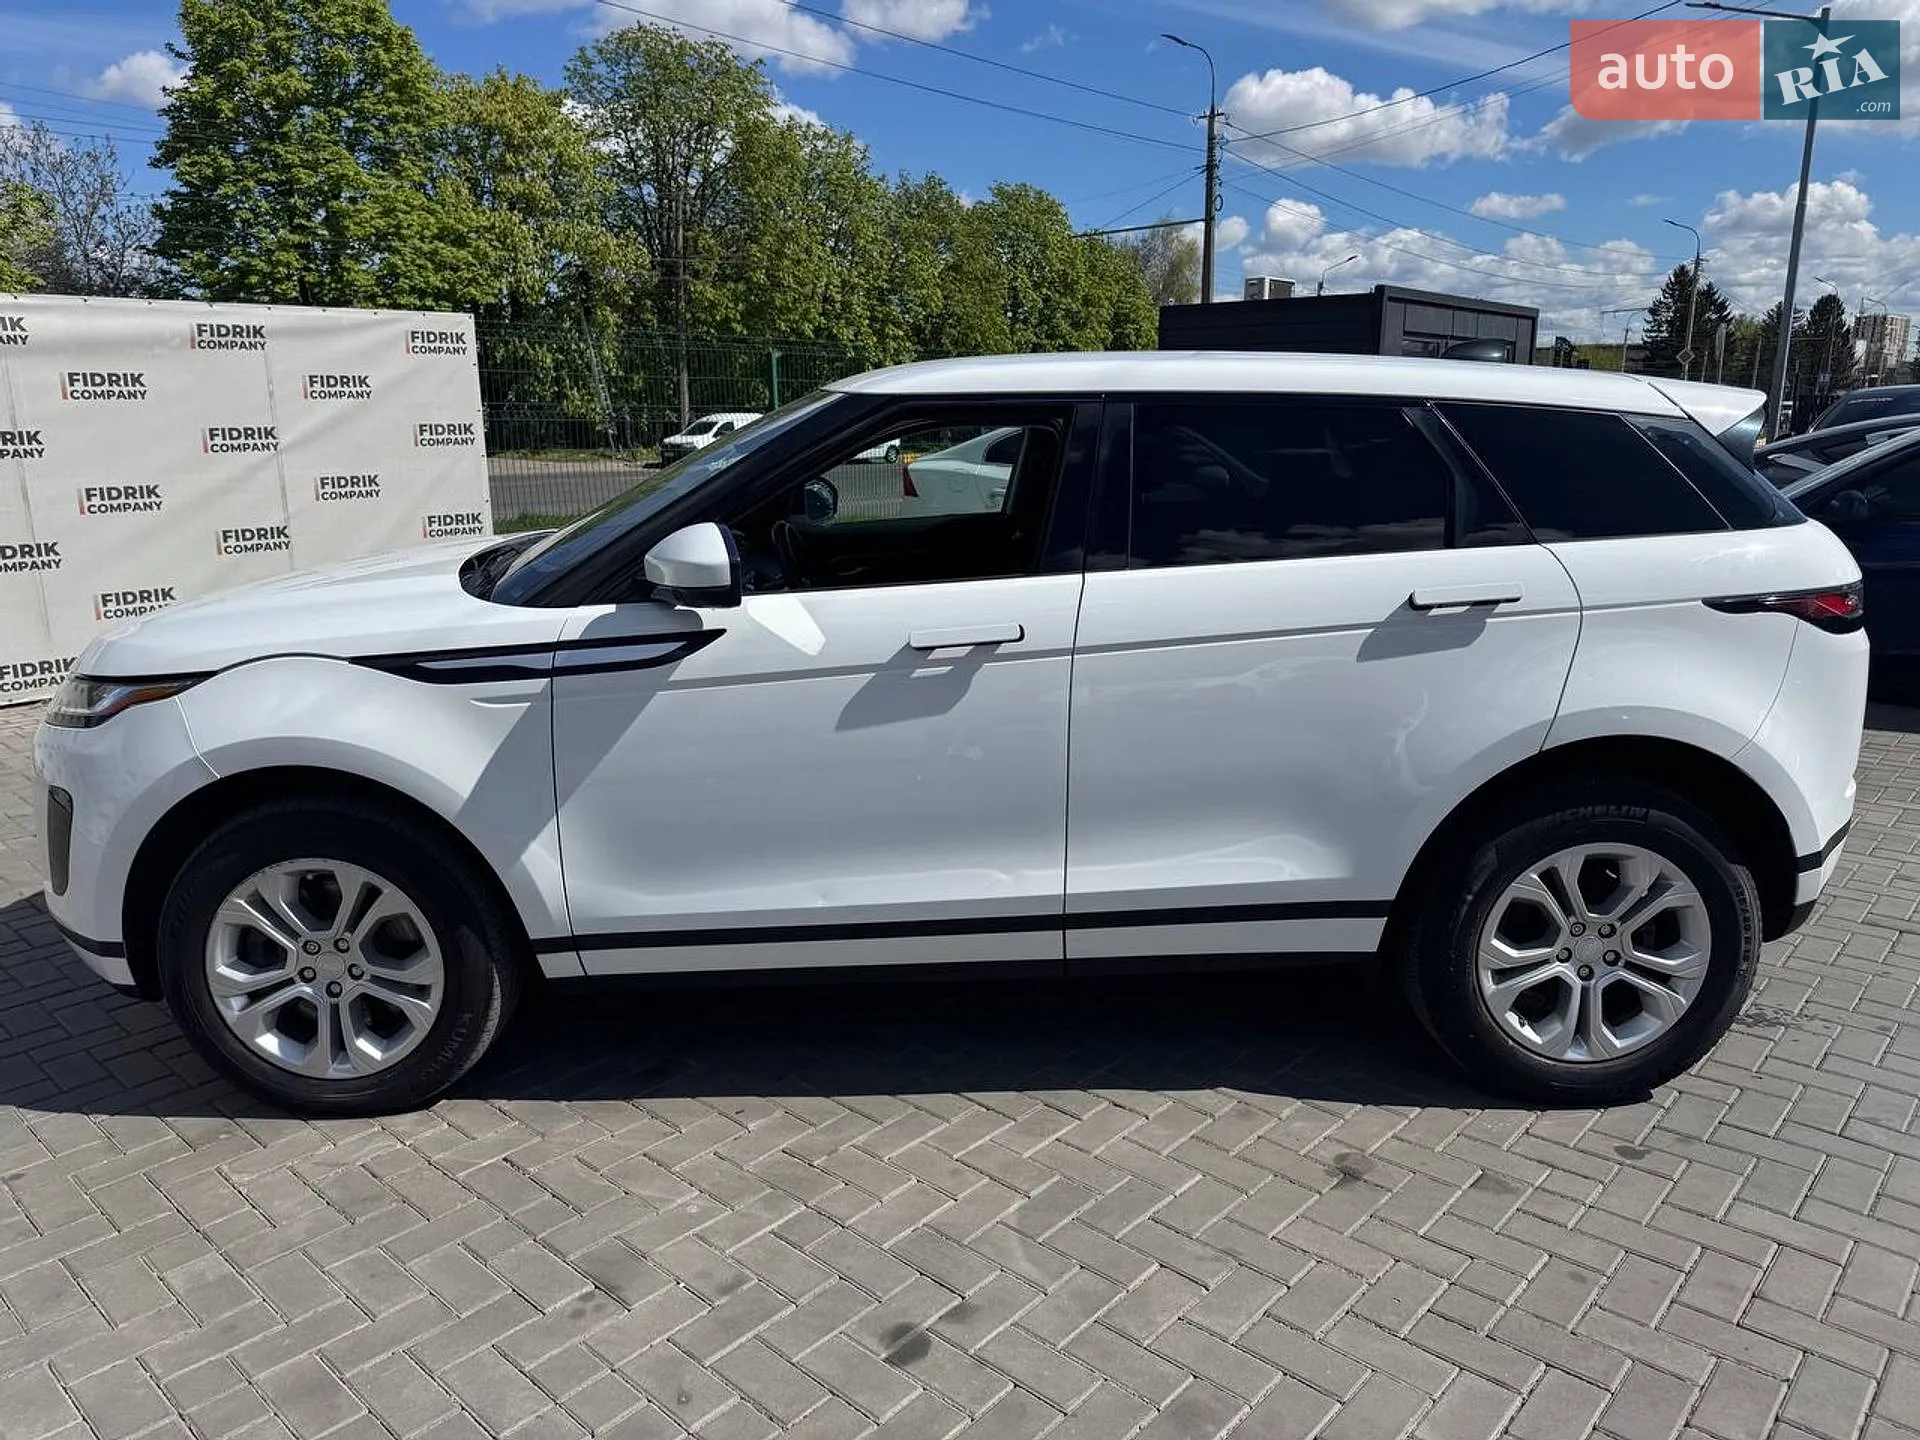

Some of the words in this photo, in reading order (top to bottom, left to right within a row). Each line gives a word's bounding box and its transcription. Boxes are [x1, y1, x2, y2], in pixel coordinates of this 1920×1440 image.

[196, 323, 266, 341] FIDRIK
[410, 330, 467, 345] FIDRIK
[197, 339, 267, 352] COMPANY
[411, 344, 467, 356] COMPANY
[68, 372, 146, 388] FIDRIK
[308, 374, 371, 389] FIDRIK
[70, 388, 147, 401] COMPANY
[310, 388, 372, 400] COMPANY
[208, 426, 278, 442] FIDRIK
[419, 422, 475, 437] FIDRIK
[209, 441, 279, 453] COMPANY
[420, 435, 476, 447] COMPANY
[319, 474, 380, 490] FIDRIK
[84, 485, 162, 502] FIDRIK
[321, 487, 381, 501] COMPANY
[86, 501, 163, 514] COMPANY
[427, 513, 483, 529] FIDRIK
[222, 525, 290, 543] FIDRIK
[428, 525, 484, 538] COMPANY
[223, 540, 291, 555] COMPANY
[0, 558, 62, 573] MPANY
[101, 586, 176, 607] FIDRIK
[103, 604, 168, 620] COMPA
